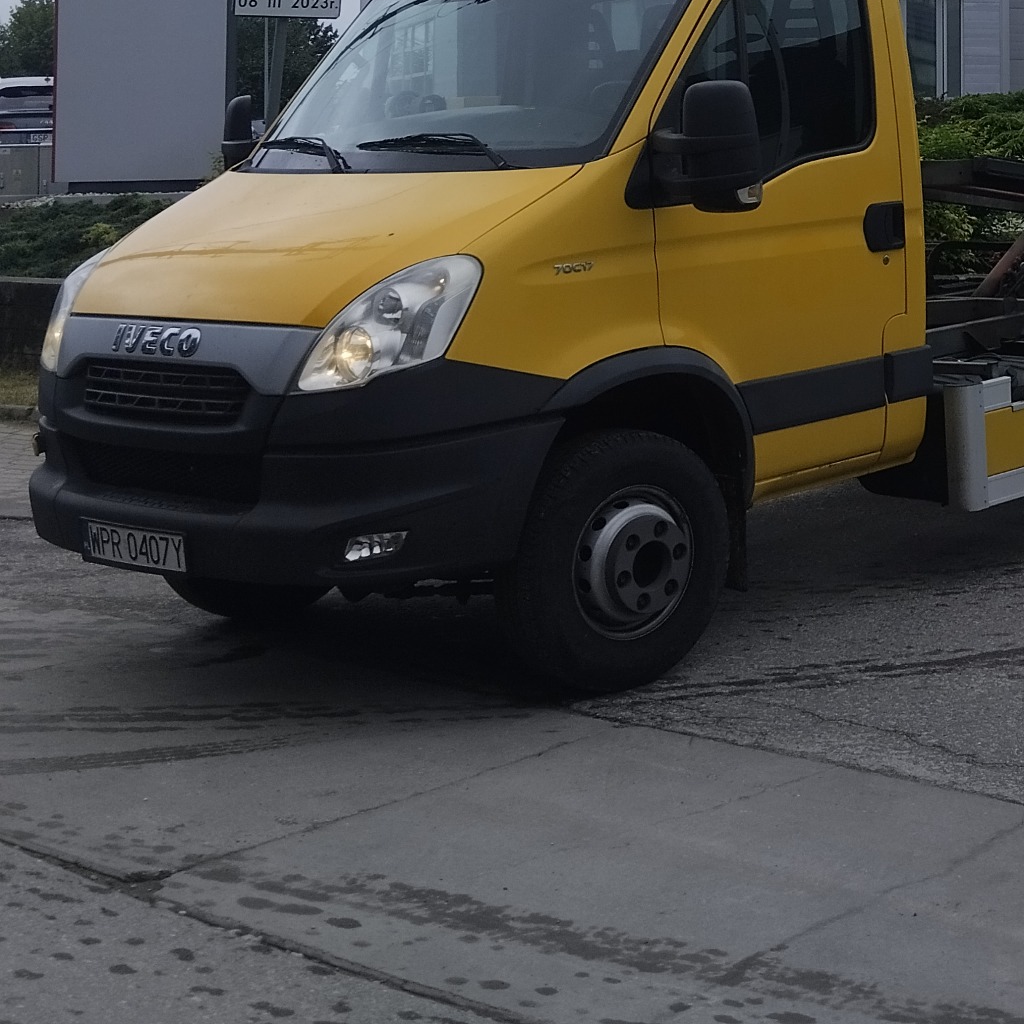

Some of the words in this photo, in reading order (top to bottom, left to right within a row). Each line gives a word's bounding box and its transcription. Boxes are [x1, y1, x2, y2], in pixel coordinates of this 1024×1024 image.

[111, 323, 202, 358] IVECO
[89, 524, 123, 559] WPR
[127, 532, 182, 569] 0407Y
